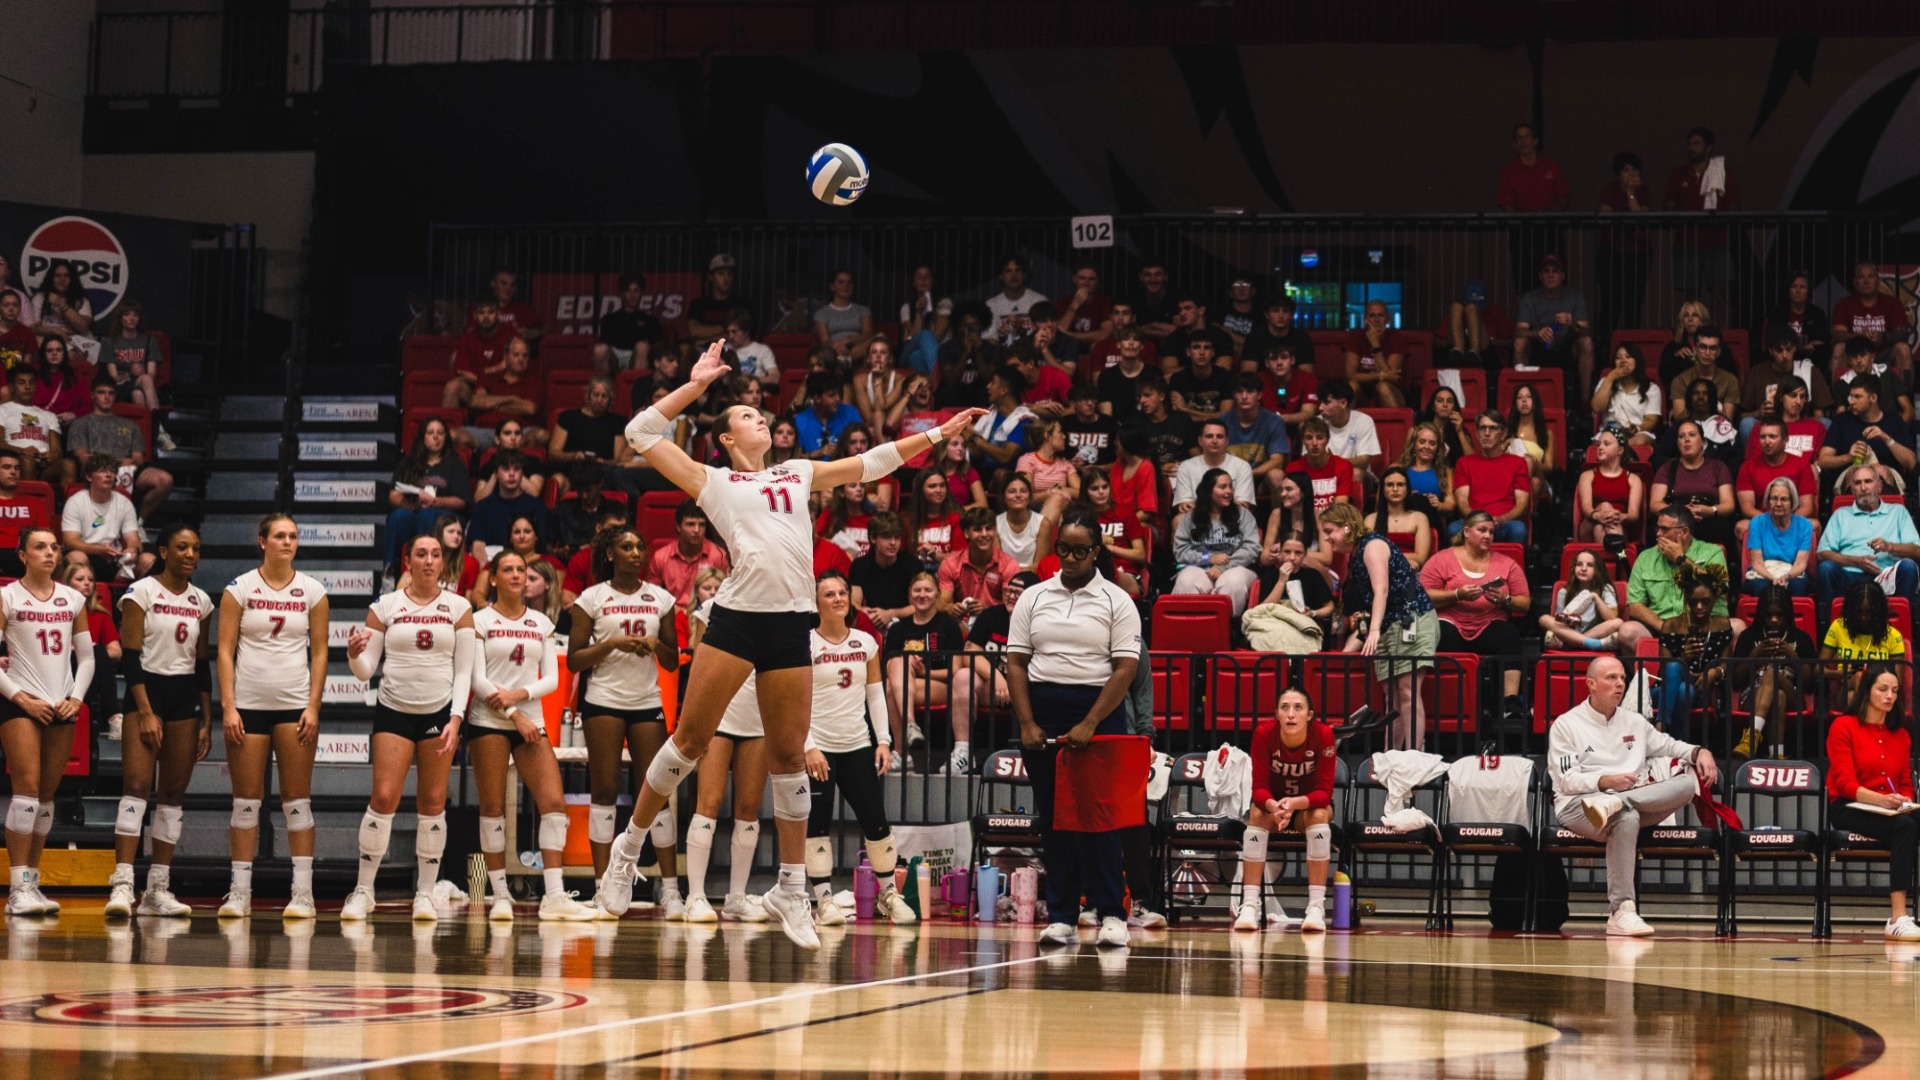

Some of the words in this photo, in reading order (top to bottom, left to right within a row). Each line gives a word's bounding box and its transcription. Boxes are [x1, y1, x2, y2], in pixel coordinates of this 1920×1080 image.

[1075, 222, 1111, 242] 102
[557, 294, 683, 320] EDDE'S
[1068, 433, 1109, 448] SIUE
[340, 487, 375, 497] ARENA
[760, 486, 792, 514] 11
[0, 506, 30, 519] IUE
[337, 530, 374, 540] ARENA
[1102, 523, 1124, 537] UE
[334, 578, 373, 588] ARENA
[248, 599, 306, 613] COUGARS
[602, 606, 659, 616] COUGARS
[16, 610, 73, 623] COUGARS
[175, 622, 188, 644] 6
[269, 616, 285, 639] 7
[620, 619, 647, 637] 16
[36, 629, 63, 655] 13
[416, 630, 434, 651] 8
[487, 629, 543, 641] COUGARS
[509, 643, 525, 666] 4
[838, 668, 852, 689] 3
[328, 683, 369, 694] ARENA
[327, 742, 369, 753] ARENA
[998, 756, 1029, 776] SI
[1271, 759, 1316, 777] SIUE
[1475, 755, 1501, 771] 19
[1750, 766, 1811, 787] SIUE
[1285, 780, 1299, 795] 5
[988, 818, 1032, 827] COUGARS
[1176, 822, 1219, 831] COUGARS
[1365, 826, 1407, 835] COUGA
[1459, 827, 1503, 836] COUGARS
[1652, 830, 1697, 839] COUGARS
[1749, 834, 1794, 843] COUGARS
